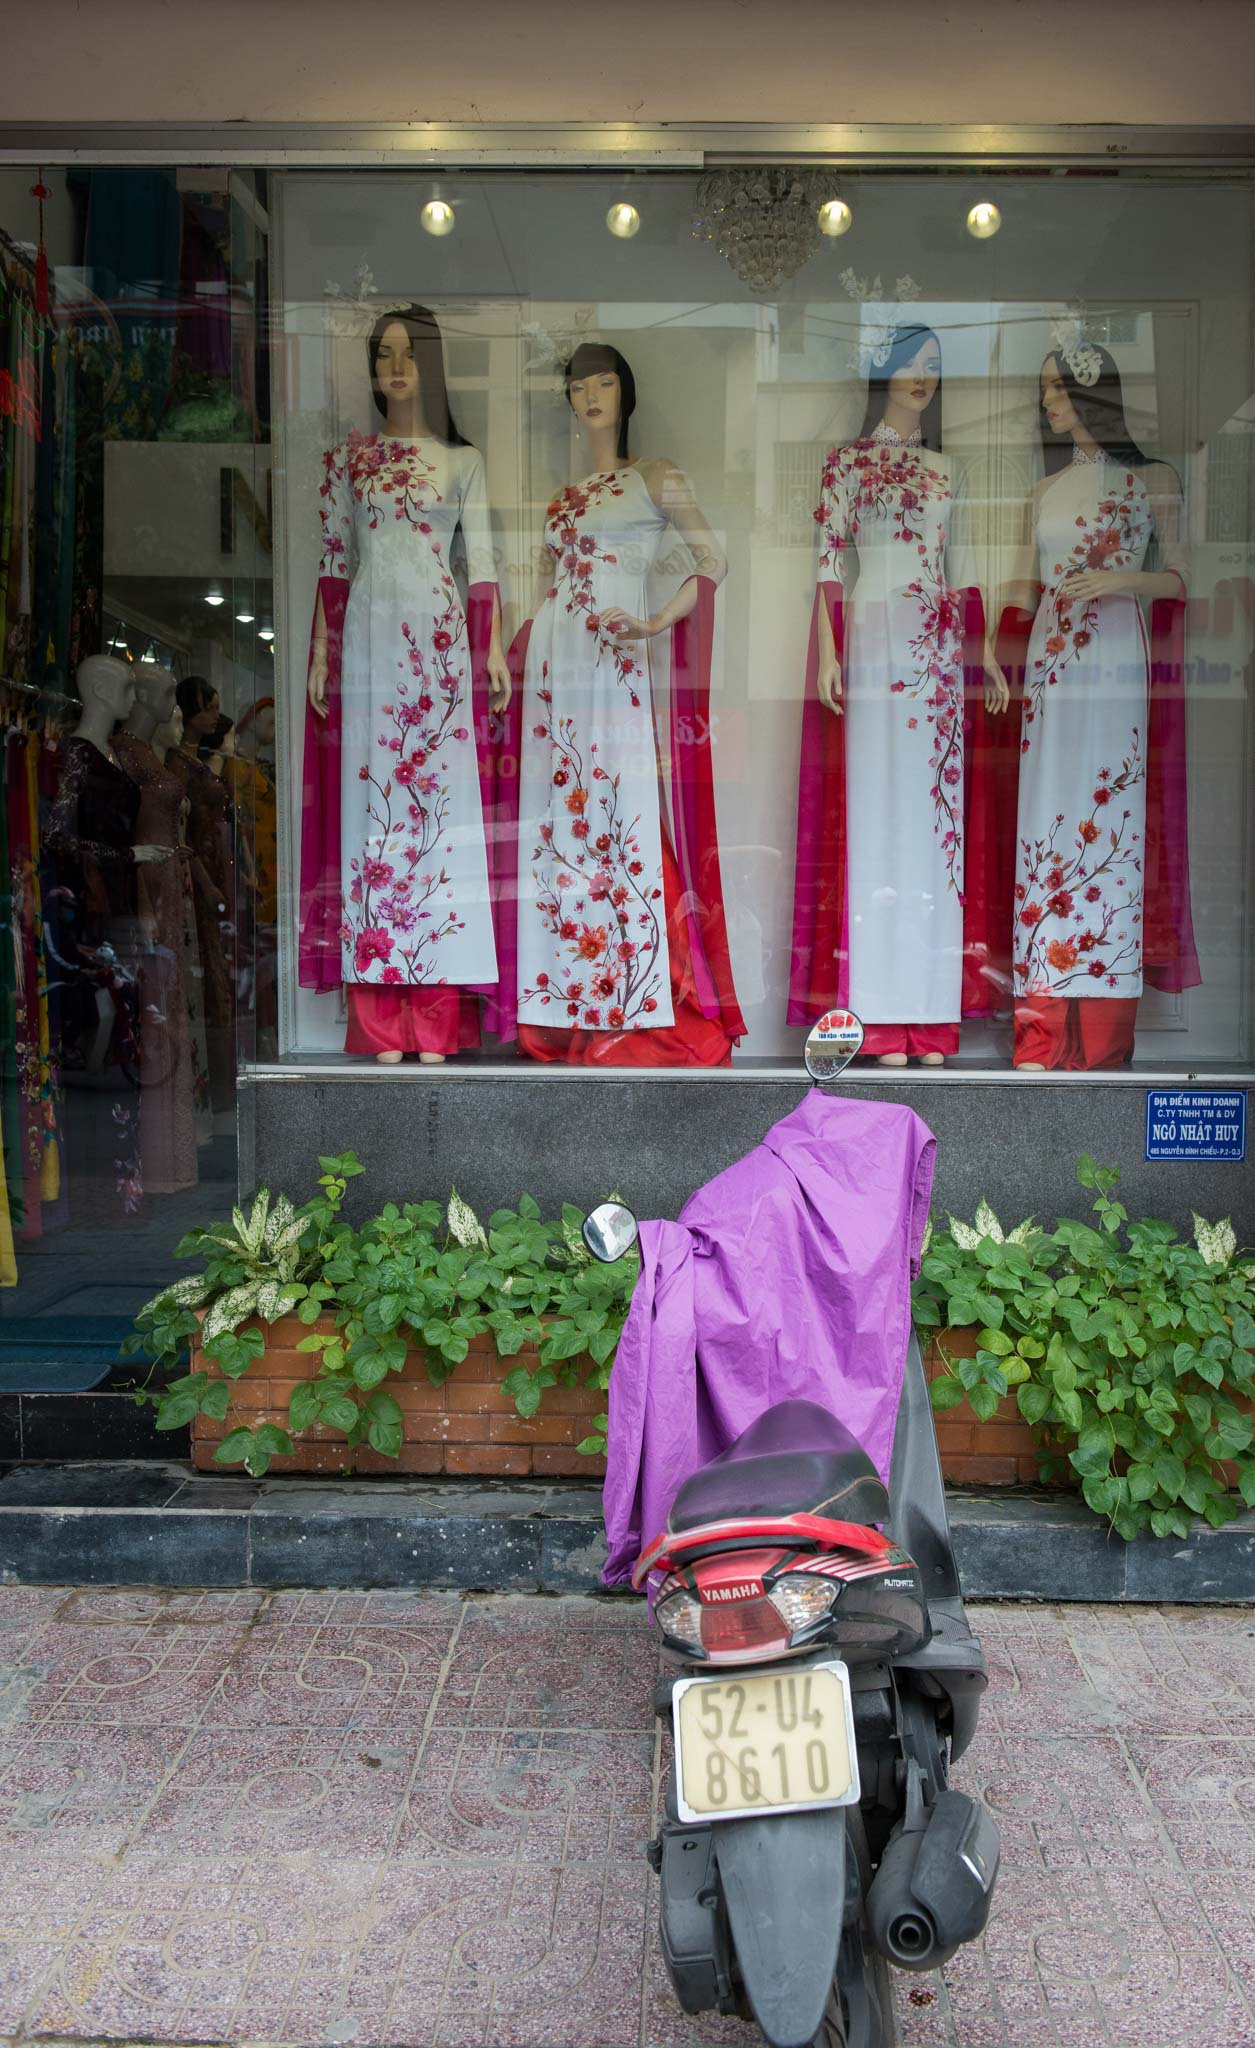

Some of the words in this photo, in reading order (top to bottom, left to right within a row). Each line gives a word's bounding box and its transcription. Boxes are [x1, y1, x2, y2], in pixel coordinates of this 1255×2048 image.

[1154, 1097, 1168, 1107] ĐỊA
[1169, 1093, 1190, 1106] ĐIỂM
[1192, 1097, 1211, 1106] KINH
[1213, 1097, 1240, 1107] DOANH
[1157, 1109, 1176, 1118] C.TY
[1178, 1109, 1201, 1118] TNHH
[1202, 1109, 1214, 1118] TM
[1216, 1109, 1222, 1118] &
[1224, 1109, 1236, 1118] DV
[1152, 1120, 1177, 1141] NGÔ
[1180, 1120, 1213, 1145] NHẬT
[1214, 1124, 1240, 1141] HUY
[702, 1581, 761, 1602] YAMAHA
[884, 1578, 915, 1588] AUTOMATIC
[705, 1738, 830, 1805] 8610
